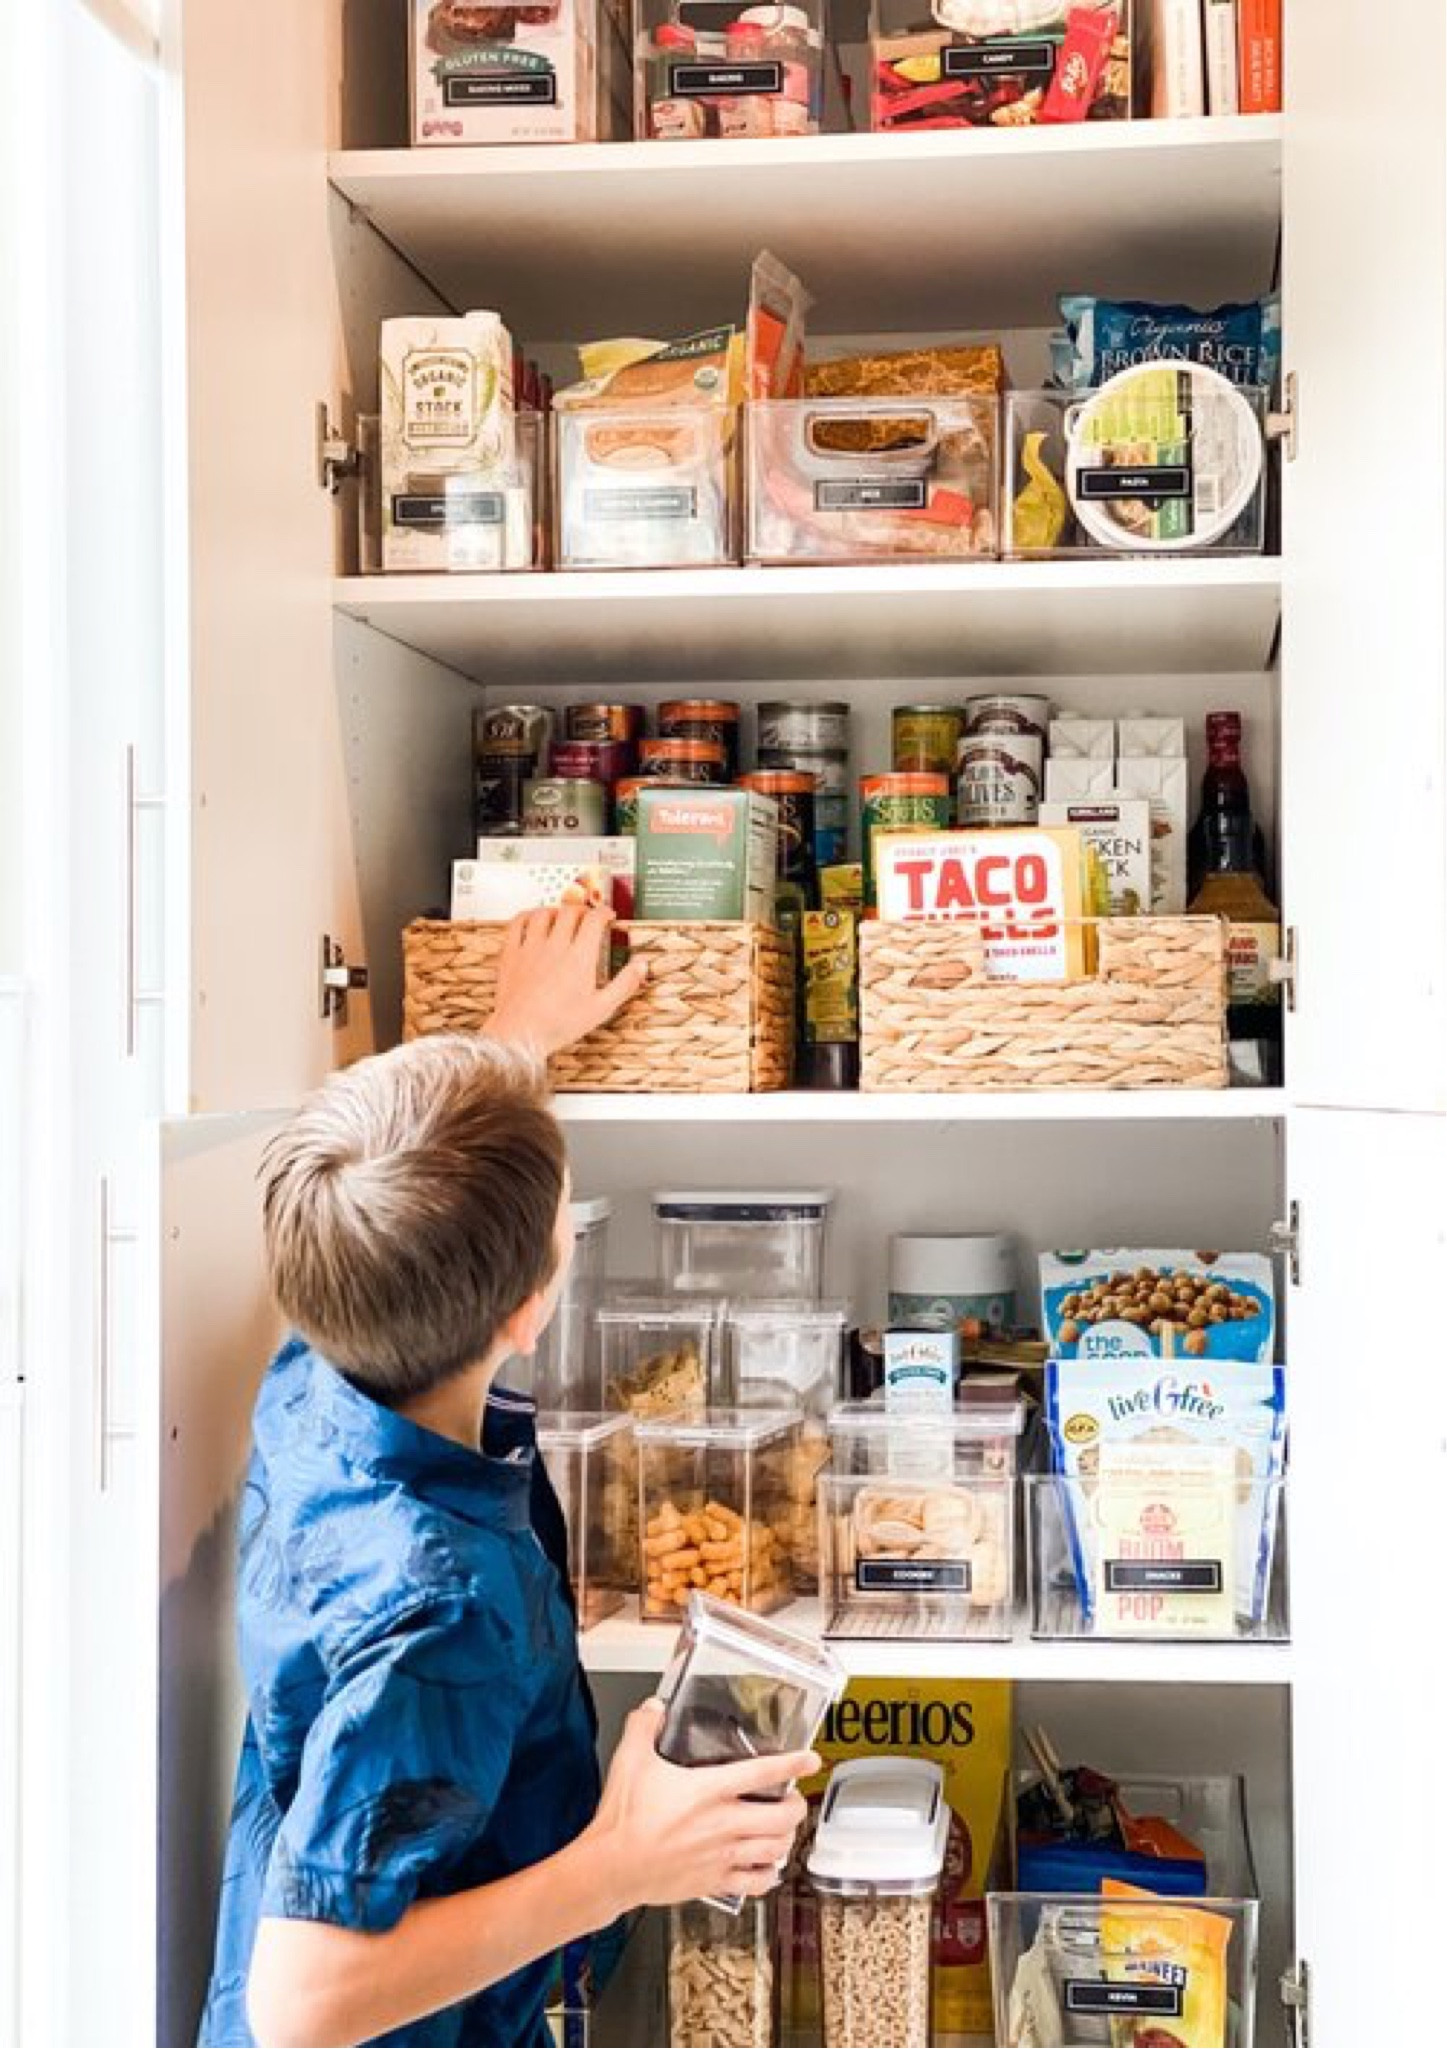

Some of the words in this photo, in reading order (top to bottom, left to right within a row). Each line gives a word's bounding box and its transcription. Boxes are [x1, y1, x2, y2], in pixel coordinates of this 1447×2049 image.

[445, 51, 497, 71] GLUTEN
[502, 52, 541, 70] FREE
[1101, 340, 1192, 368] BROWN
[1199, 338, 1258, 366] RICE
[893, 853, 1048, 910] TACO
[1084, 1336, 1123, 1351] the
[1118, 1596, 1164, 1621] POP
[825, 1697, 976, 1747] eerios
